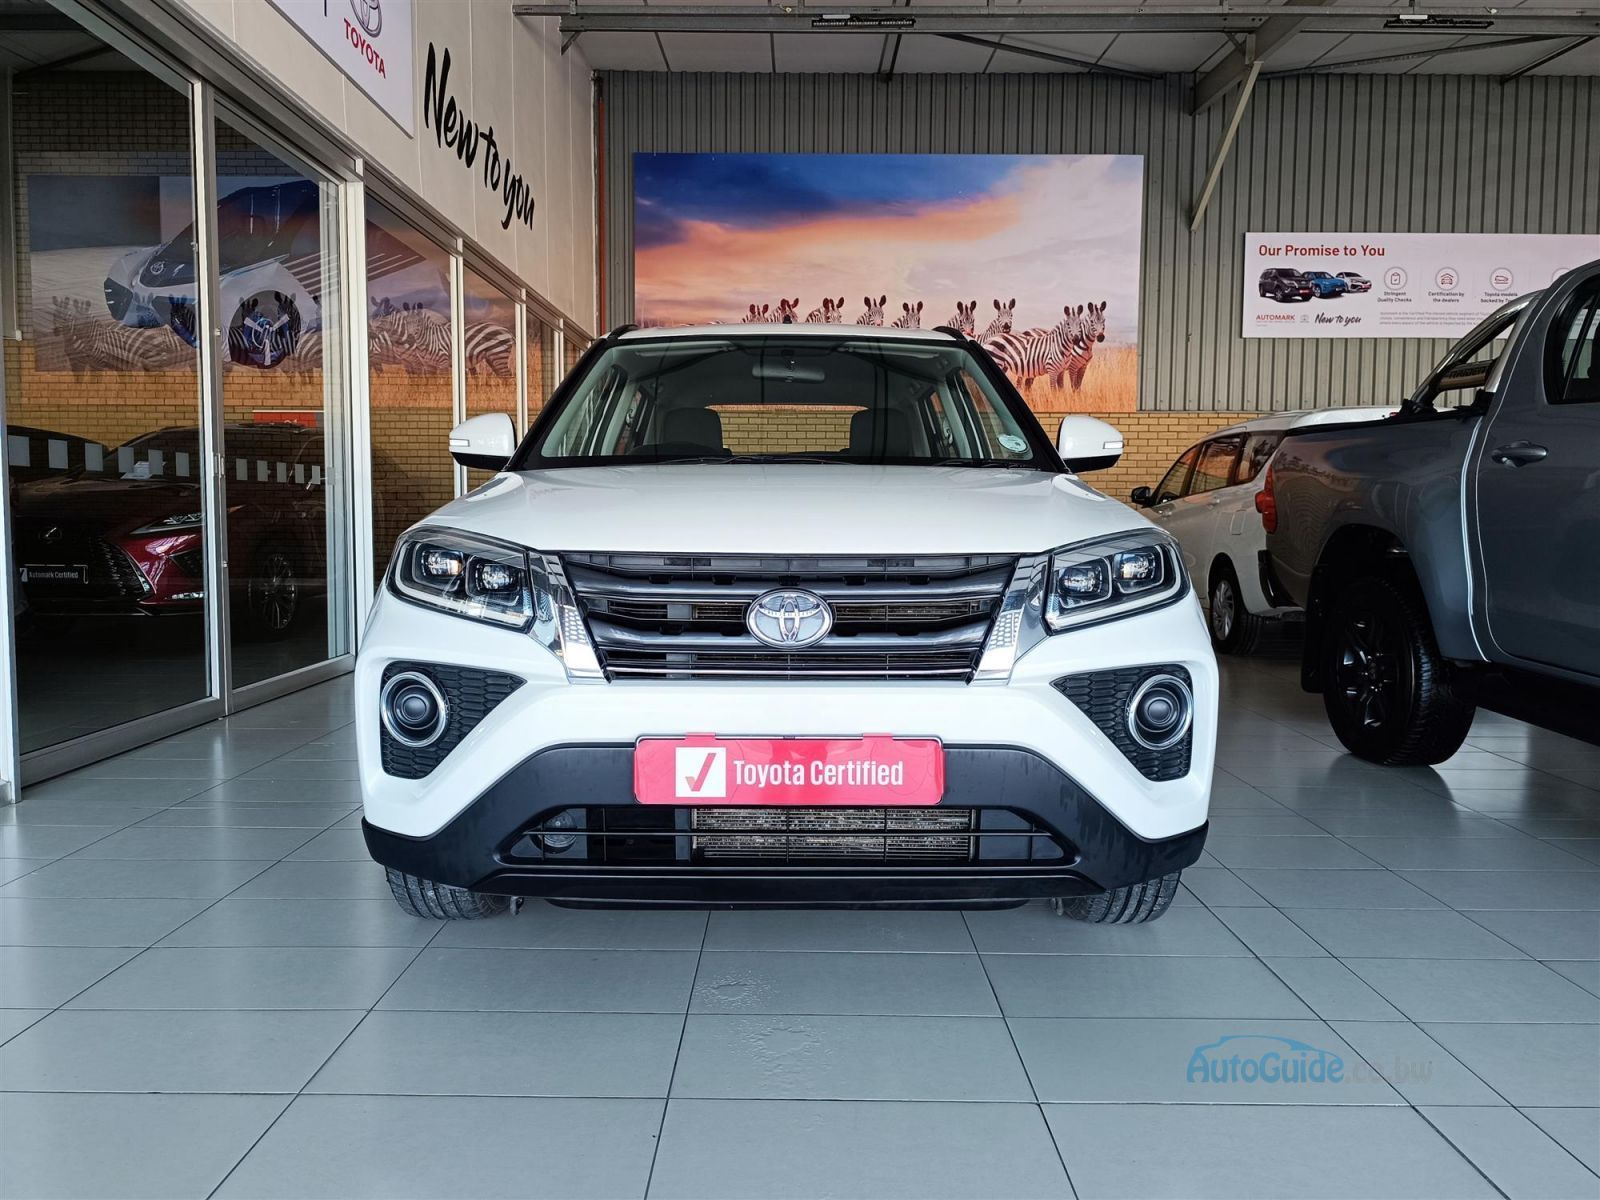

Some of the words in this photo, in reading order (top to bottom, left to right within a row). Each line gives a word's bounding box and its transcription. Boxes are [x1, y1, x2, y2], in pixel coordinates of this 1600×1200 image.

[343, 18, 386, 79] TOYOTA
[424, 41, 478, 168] New
[479, 126, 500, 191] to
[501, 158, 535, 231] you
[1259, 245, 1281, 257] Our
[1285, 245, 1340, 257] Promise
[1343, 245, 1357, 257] to
[1361, 245, 1385, 257] You
[1315, 312, 1334, 324] New
[1335, 314, 1345, 323] to
[1344, 316, 1362, 327] you
[54, 571, 79, 579] Certified
[733, 760, 805, 788] Toyota
[810, 760, 904, 785] Certified
